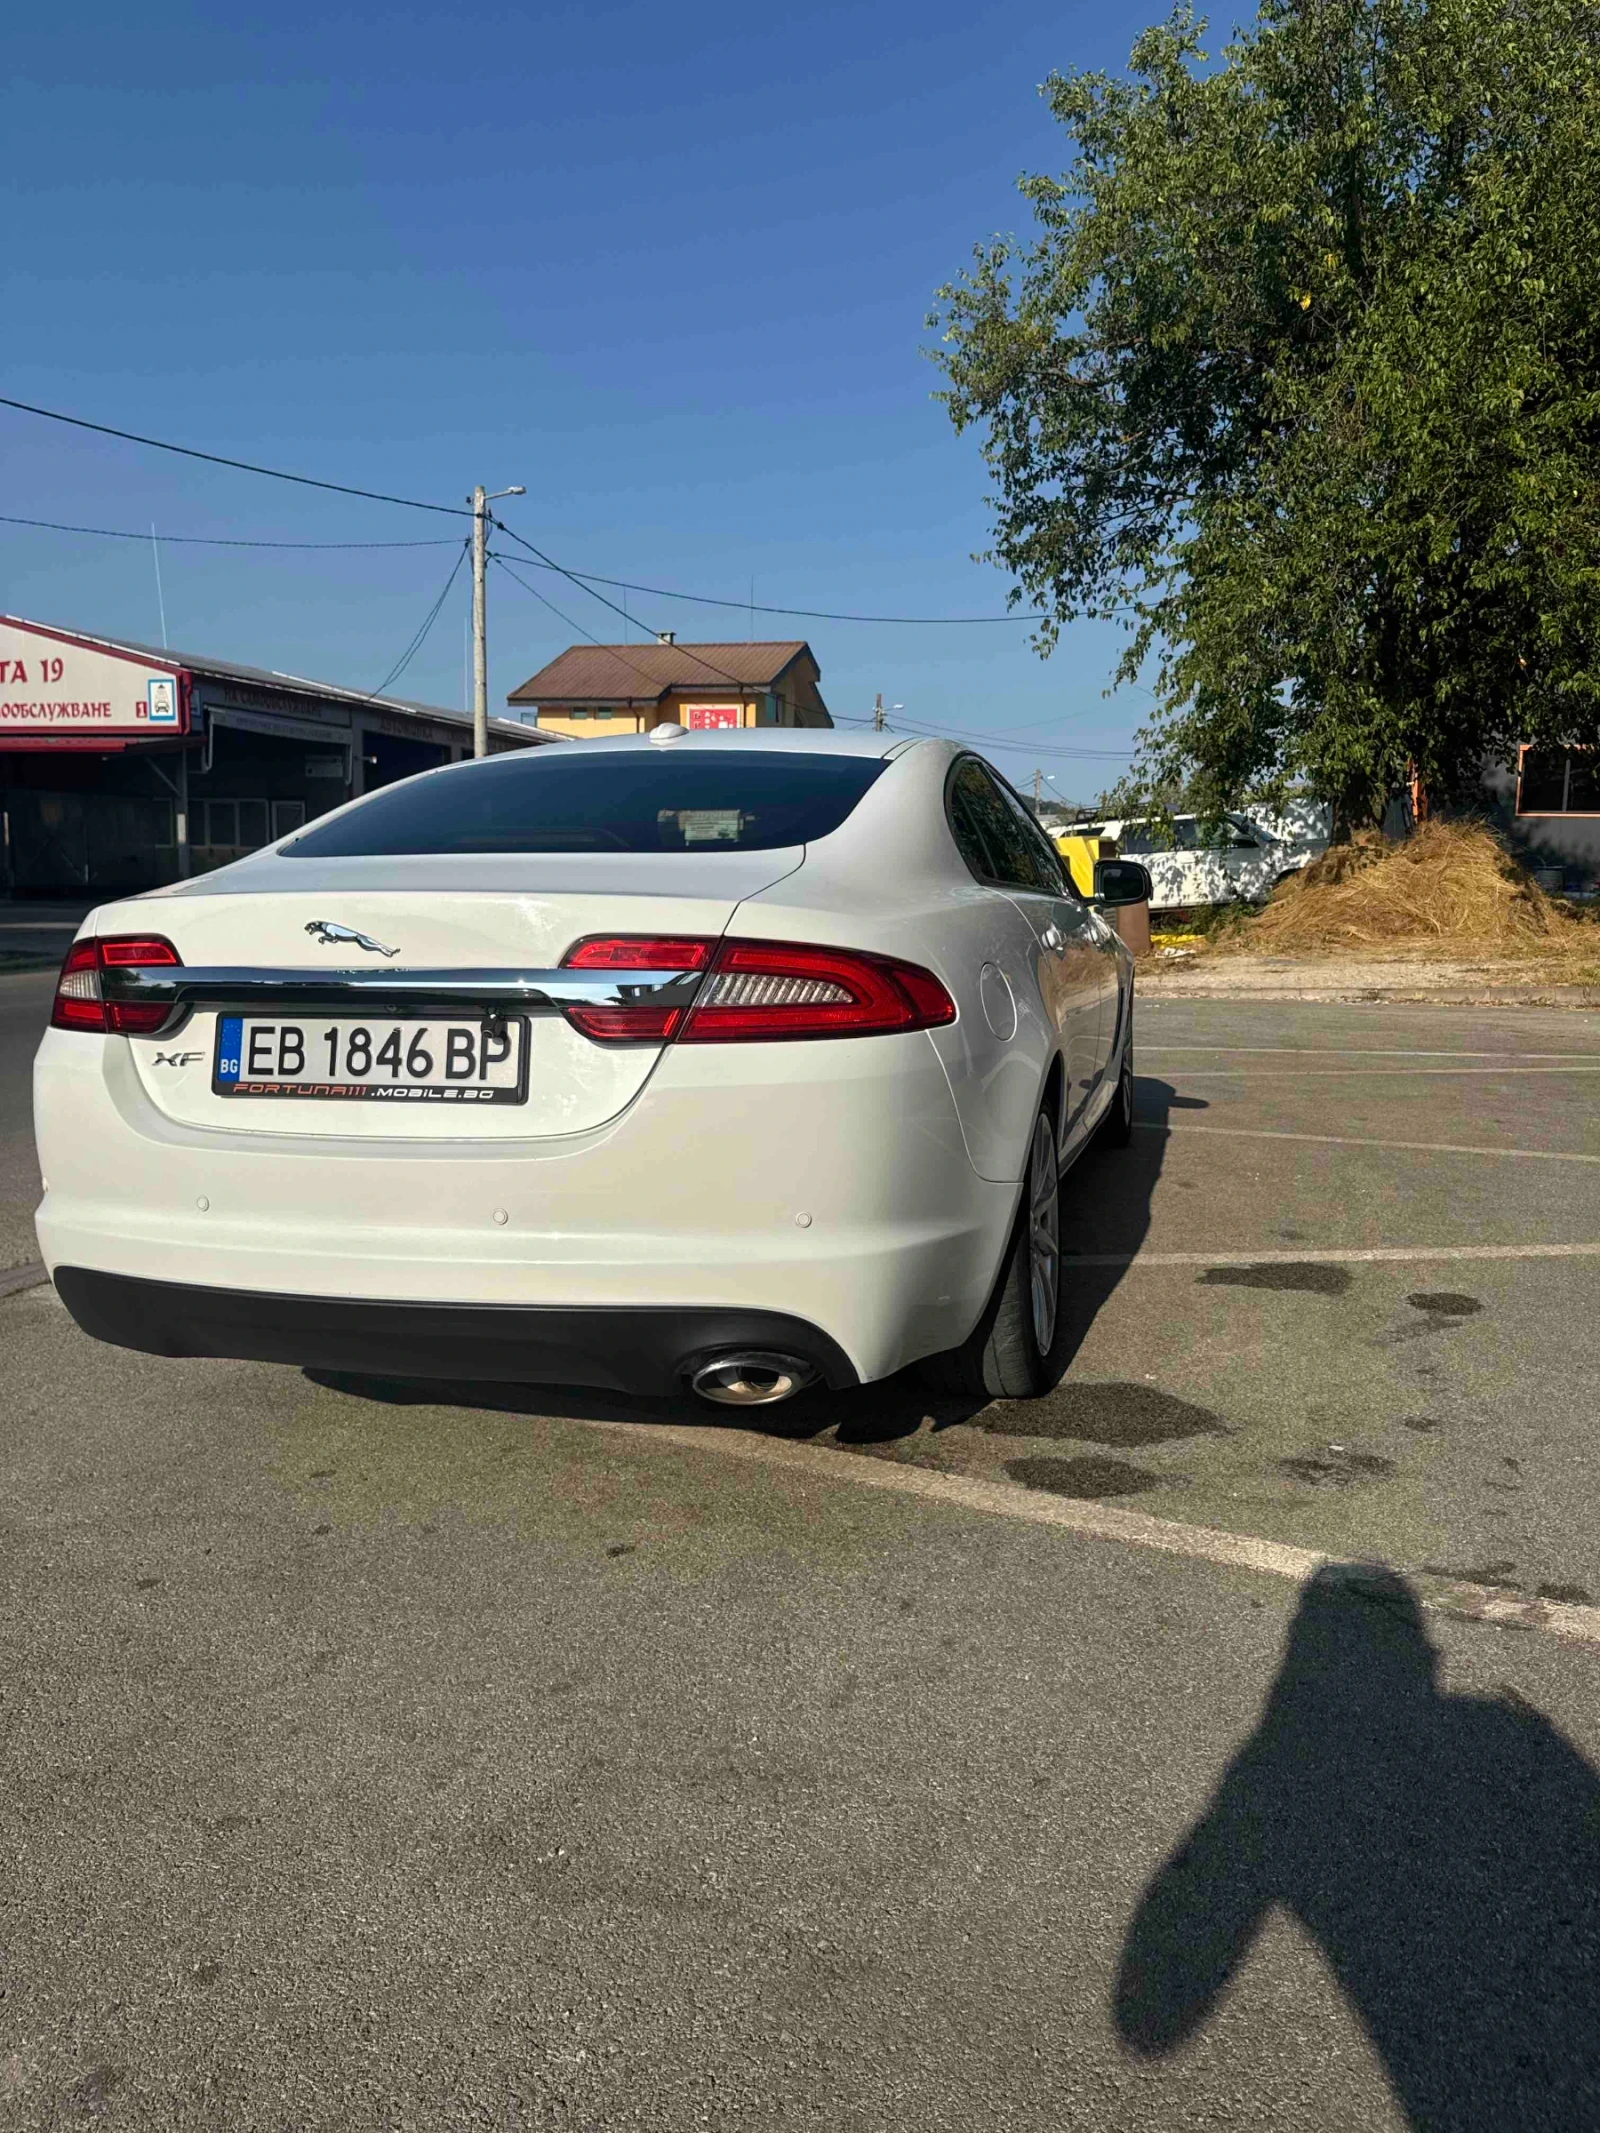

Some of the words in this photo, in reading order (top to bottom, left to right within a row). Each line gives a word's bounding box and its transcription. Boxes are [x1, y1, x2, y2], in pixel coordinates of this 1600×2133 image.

[40, 658, 64, 683] 19
[0, 701, 112, 721] ООБСЛУЖВАНЕ
[151, 1051, 206, 1067] XF
[248, 1026, 305, 1076] EB
[324, 1026, 433, 1078] 1846
[445, 1027, 511, 1080] BP
[220, 1059, 239, 1074] BG
